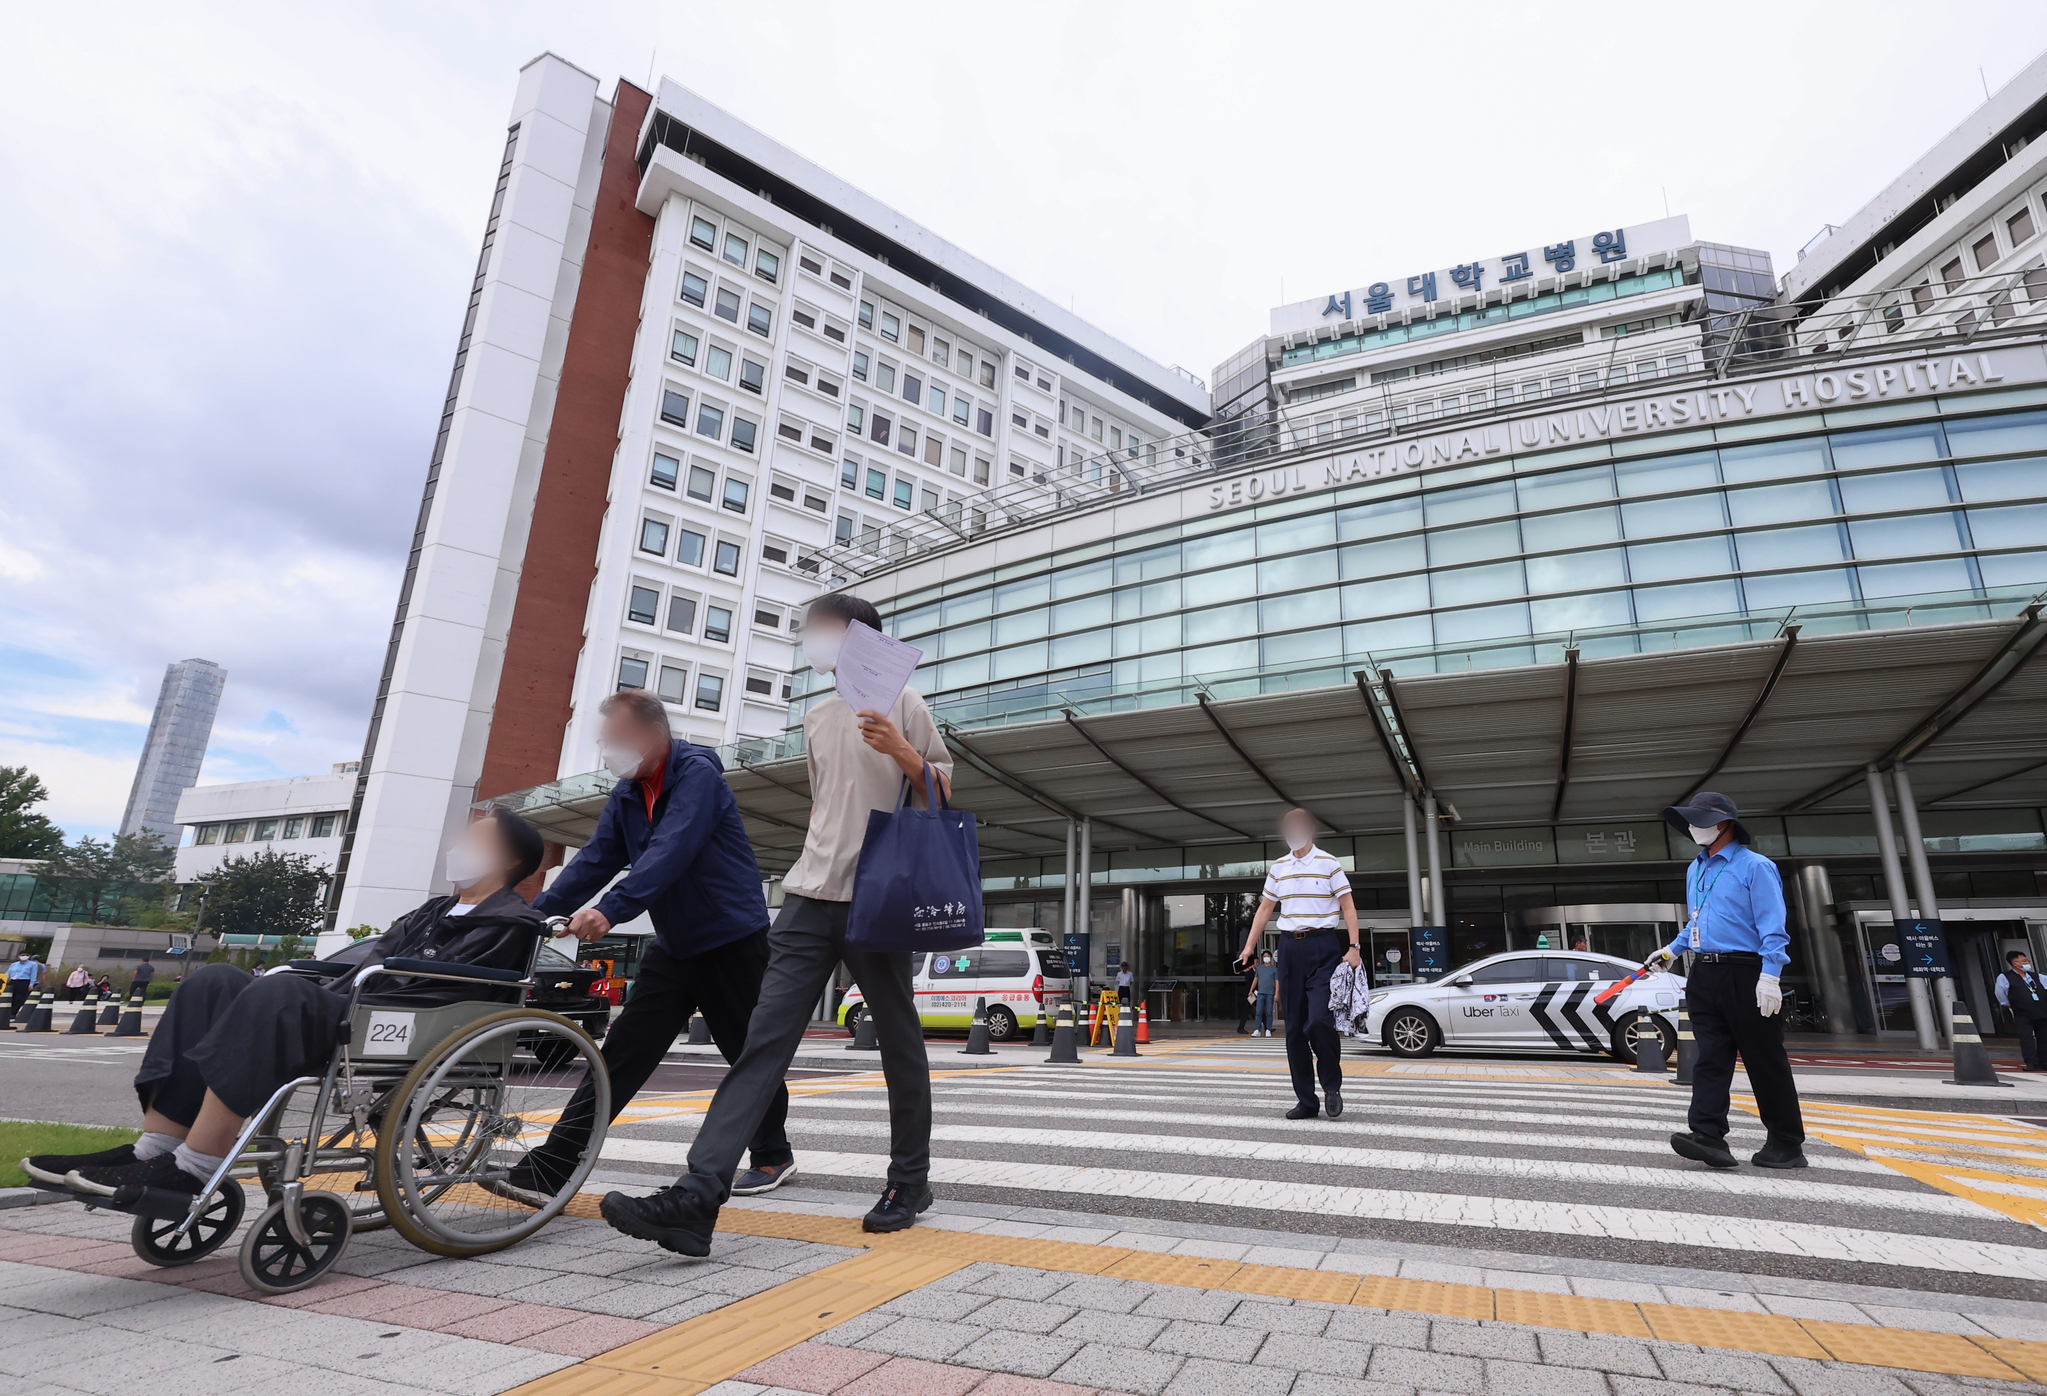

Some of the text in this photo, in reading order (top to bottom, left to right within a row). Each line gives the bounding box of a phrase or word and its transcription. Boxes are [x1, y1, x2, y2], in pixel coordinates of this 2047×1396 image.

[1321, 228, 1627, 320] 서울대학교병원
[1209, 352, 2006, 510] SEOUL NATIONAL UNIVERSITY HOSPITAL
[1463, 839, 1543, 853] Main Building
[1585, 830, 1636, 854] 본관
[1463, 1005, 1520, 1018] Uber Taxi
[370, 1024, 407, 1042] 224
